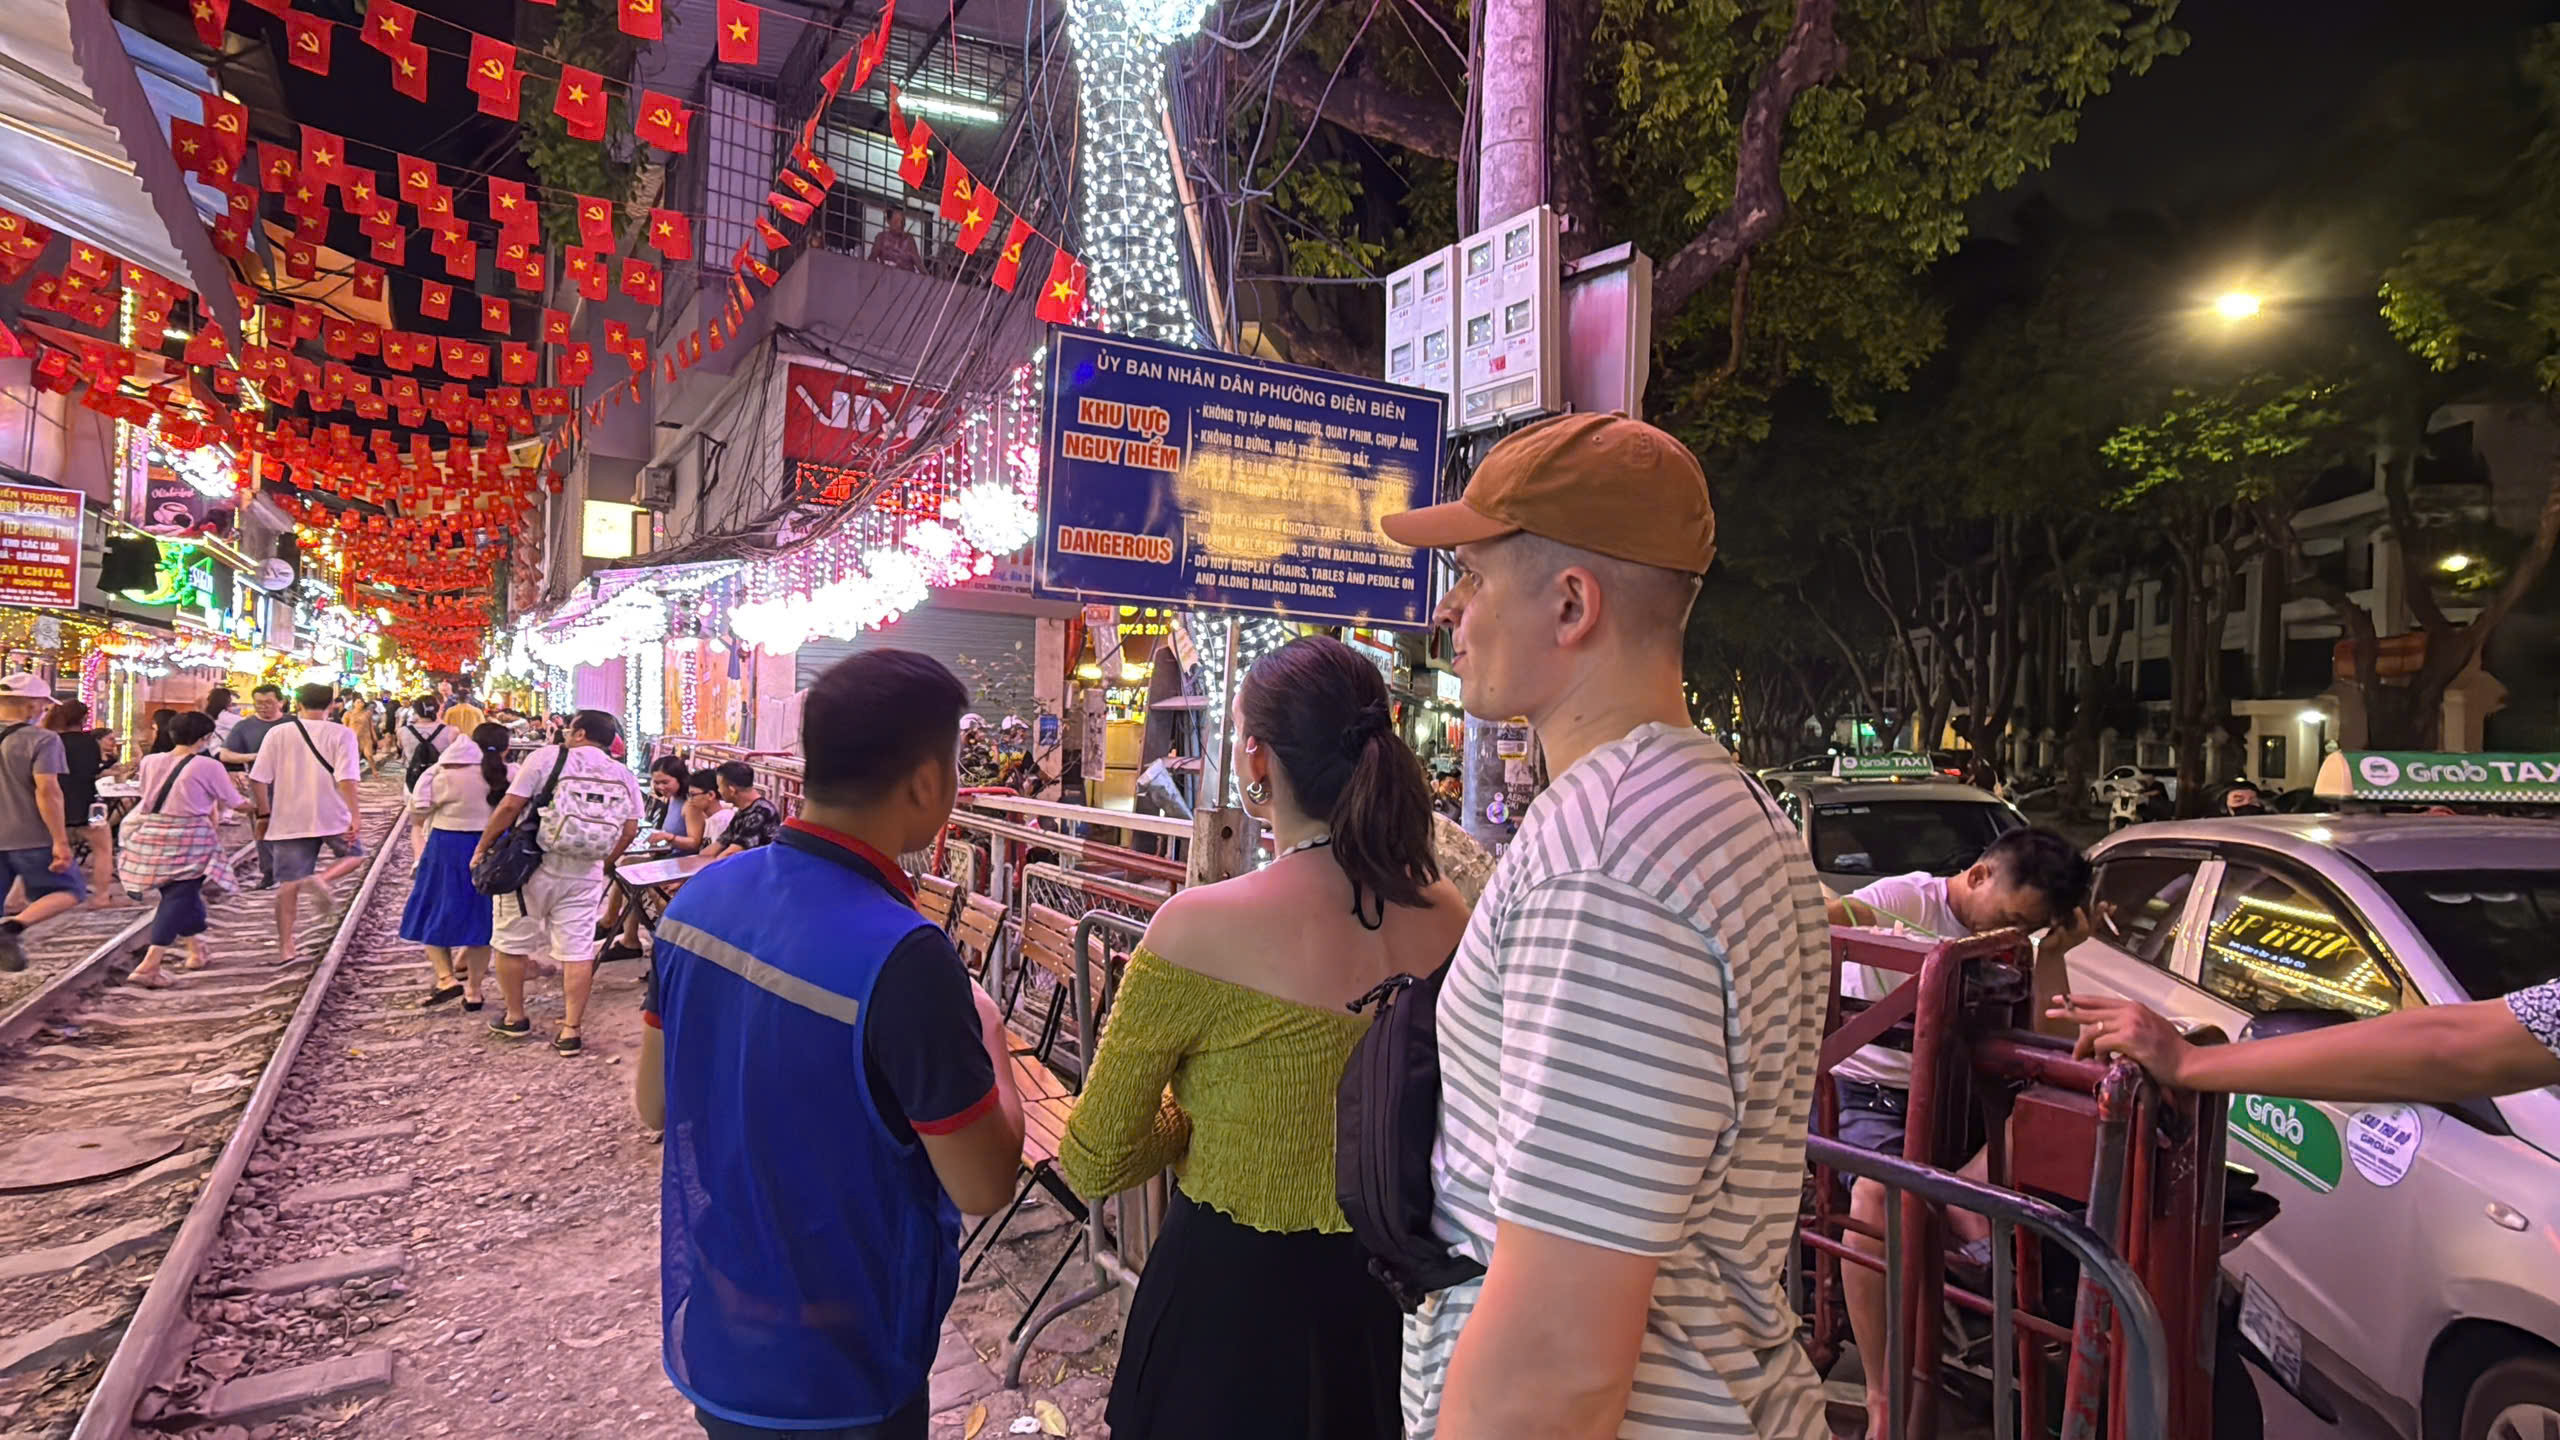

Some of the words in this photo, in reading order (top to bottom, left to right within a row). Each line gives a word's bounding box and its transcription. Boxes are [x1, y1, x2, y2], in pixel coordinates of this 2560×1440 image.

[1098, 348, 1121, 372] ỦY
[1126, 359, 1162, 379] BAN
[1168, 366, 1215, 388] NHÂN
[1220, 374, 1254, 395] DÂN
[1259, 382, 1326, 407] PHƯỜNG
[1331, 393, 1366, 415] ĐIỆN
[1371, 401, 1405, 421] BIÊN
[1079, 397, 1124, 428] KHU
[1127, 405, 1170, 438] VỰC
[1202, 403, 1233, 422] KHÔNG
[1236, 410, 1247, 426] TỤ
[1250, 410, 1265, 427] TẬP
[1268, 414, 1292, 431] ĐÔNG
[1325, 425, 1347, 441] QUAY
[1350, 429, 1374, 445] PHIM,
[1376, 433, 1398, 450] CHỤP
[1400, 432, 1419, 451] ẢNH.
[1062, 431, 1123, 464] NGUY
[1125, 437, 1180, 471] HIỂM
[1200, 428, 1232, 447] KHÔNG
[1234, 434, 1244, 447] ĐI
[1198, 511, 1211, 523] DO
[1213, 512, 1233, 525] NOT
[1235, 515, 1271, 531] GATHER
[1273, 519, 1280, 531] A
[1282, 519, 1317, 537] CROWD,
[1320, 526, 1342, 539] TAKE
[1058, 526, 1172, 564] DANGEROUS
[1197, 533, 1209, 545] DO
[1212, 535, 1233, 548] NOT
[1267, 541, 1299, 557] STAND,
[1302, 544, 1316, 557] SIT
[1318, 547, 1331, 560] ON
[1333, 548, 1377, 565] RAILROAD
[1378, 554, 1414, 569] TRACKS.
[1194, 554, 1208, 567] DO
[1210, 556, 1230, 570] NOT
[1232, 559, 1271, 574] DISPLAY
[1273, 563, 1309, 580] CHAIRS,
[1311, 567, 1344, 583] TABLES
[1347, 571, 1366, 585] AND
[1367, 574, 1400, 589] PEDDLE
[1402, 578, 1415, 590] ON
[1195, 572, 1216, 585] AND
[1218, 574, 1250, 590] ALONG
[1252, 577, 1297, 594] RAILROAD
[1299, 582, 1337, 598] TRACKS.
[1892, 757, 1927, 767] TAXI
[2407, 760, 2487, 782] Grab
[2245, 1094, 2304, 1145] Grab
[2360, 1134, 2396, 1156] GROUP
